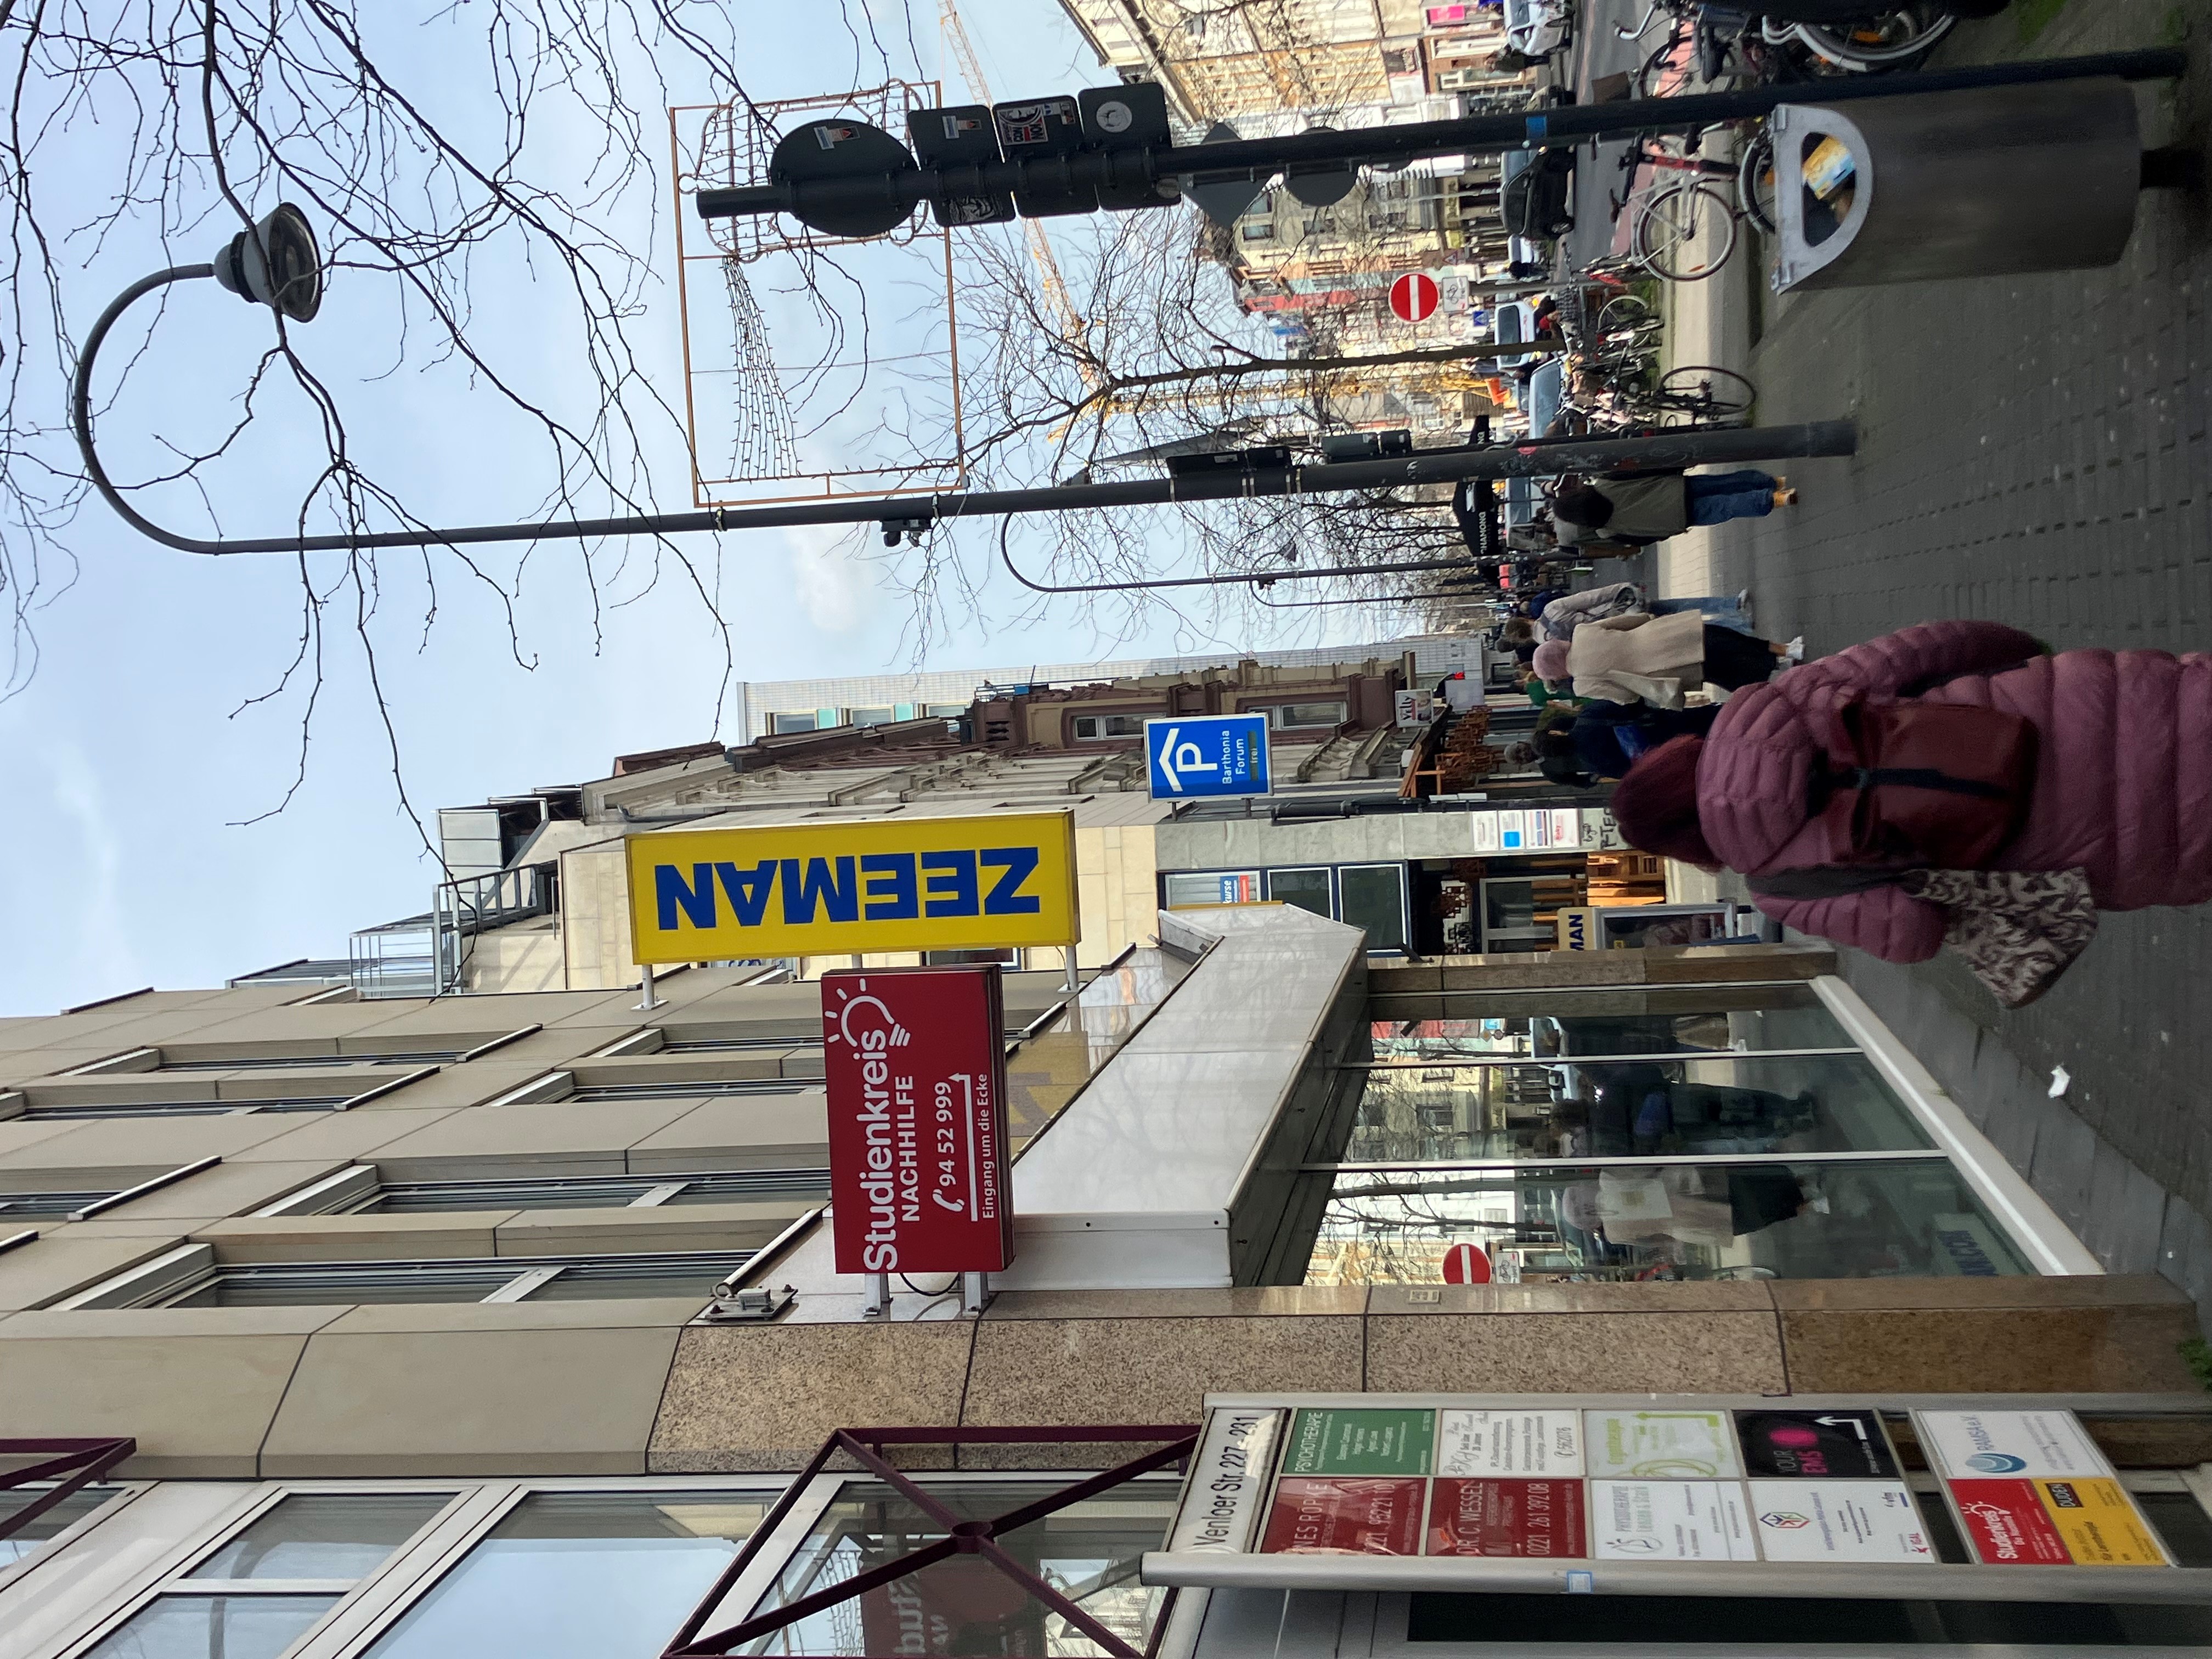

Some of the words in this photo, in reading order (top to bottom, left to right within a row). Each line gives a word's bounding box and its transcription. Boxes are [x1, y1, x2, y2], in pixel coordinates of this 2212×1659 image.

[1176, 742, 1218, 772] P
[1221, 730, 1233, 784] Barthonia
[1235, 738, 1246, 775] Forum
[654, 846, 1040, 930] ZEEMAN
[934, 1081, 952, 1122] 999
[977, 1074, 989, 1106] Ecke
[977, 1109, 990, 1132] die
[853, 1029, 898, 1271] Studienkreis
[895, 1075, 920, 1222] NACHHILFE
[936, 1127, 954, 1154] 52
[980, 1135, 991, 1158] um
[938, 1159, 956, 1187] 94
[981, 1160, 996, 1219] Eingang
[1219, 1446, 1246, 1468] 227
[1210, 1471, 1245, 1492] Str.
[1192, 1495, 1238, 1546] Venloer
